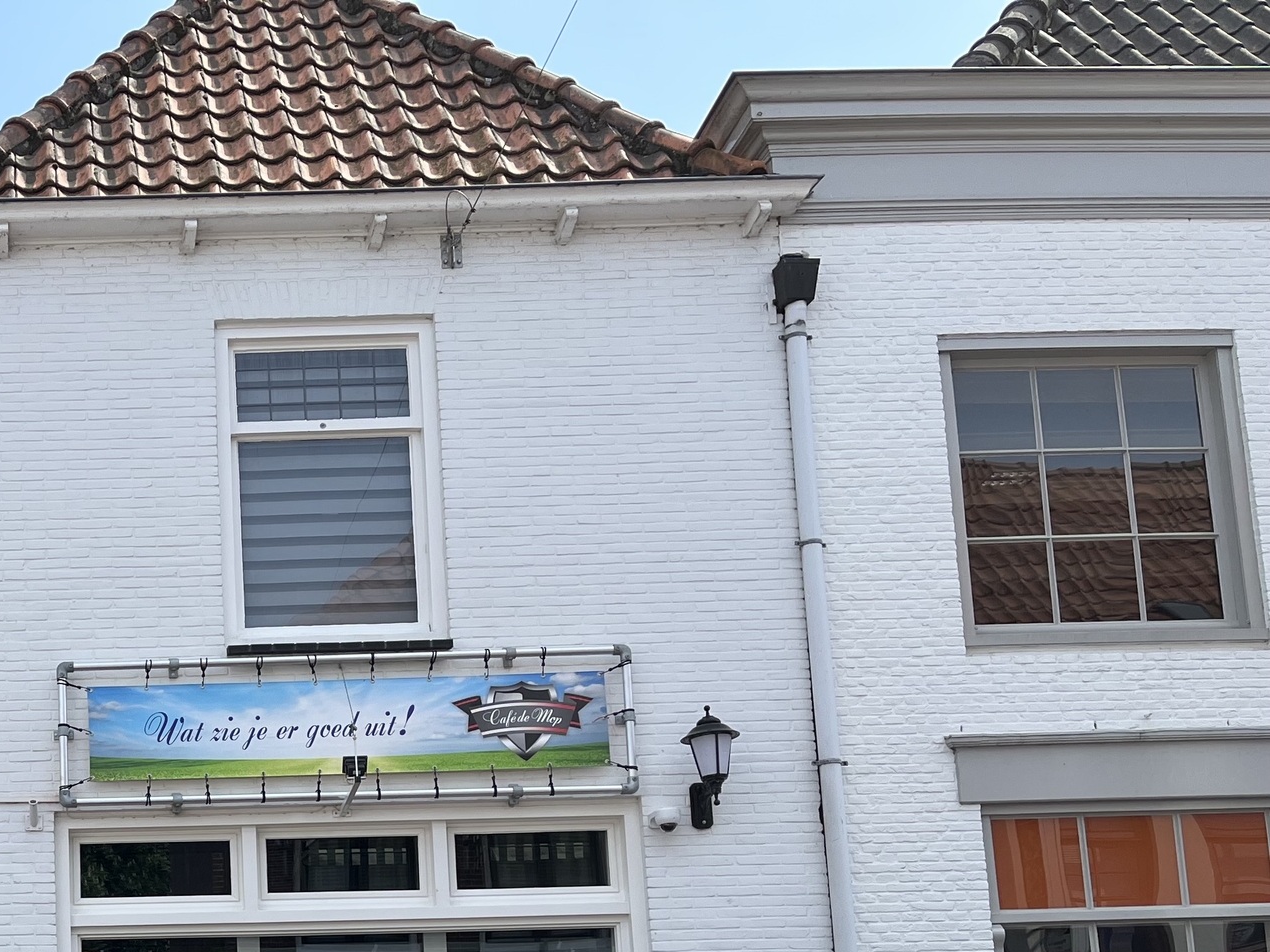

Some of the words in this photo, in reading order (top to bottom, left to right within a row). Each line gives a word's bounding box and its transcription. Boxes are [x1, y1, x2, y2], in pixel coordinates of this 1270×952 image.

[143, 711, 205, 745] Wat
[209, 716, 241, 742] zie
[242, 715, 268, 750] je
[276, 724, 299, 740] er
[305, 710, 361, 748] goed
[364, 704, 416, 737] uit!
[483, 709, 517, 727] Café
[517, 710, 530, 723] de
[531, 707, 563, 727] Mop
